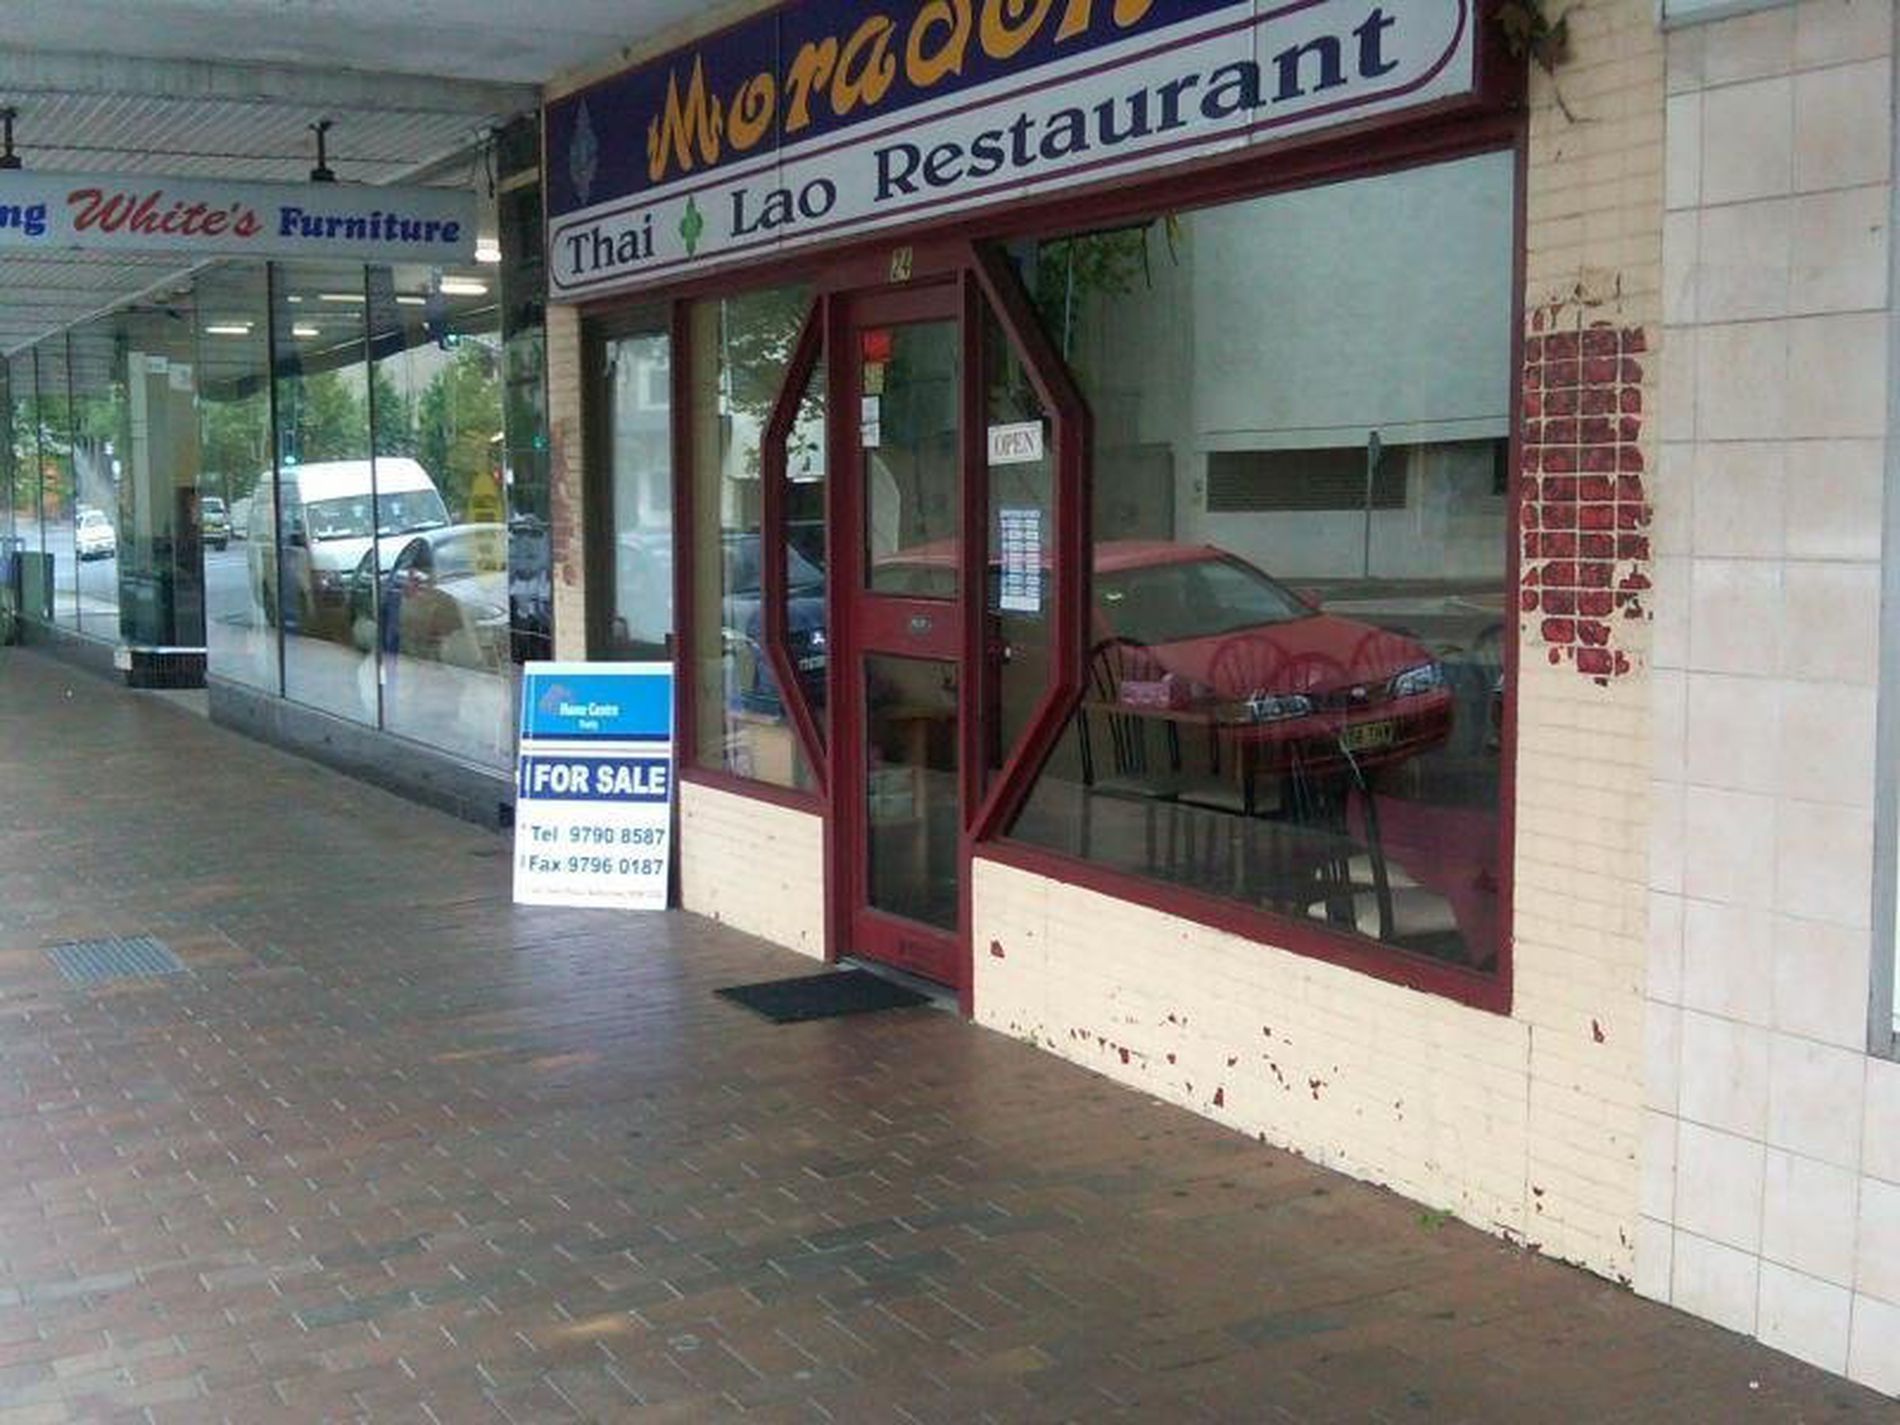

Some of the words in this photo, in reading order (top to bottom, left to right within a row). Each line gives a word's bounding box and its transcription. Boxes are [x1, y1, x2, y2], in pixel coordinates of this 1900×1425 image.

[566, 212, 655, 275] Thai
[730, 178, 838, 237] Lao
[873, 8, 1399, 202] Restaurant
[66, 188, 264, 237] White's
[278, 206, 461, 243] Furniture
[994, 430, 1035, 457] OPEN
[533, 763, 589, 794] FOR
[595, 764, 666, 796] SALE
[531, 826, 559, 843] Tel
[569, 826, 614, 844] 9790
[528, 855, 562, 873] Fax
[567, 856, 613, 874] 9796
[619, 858, 664, 876] 0187
